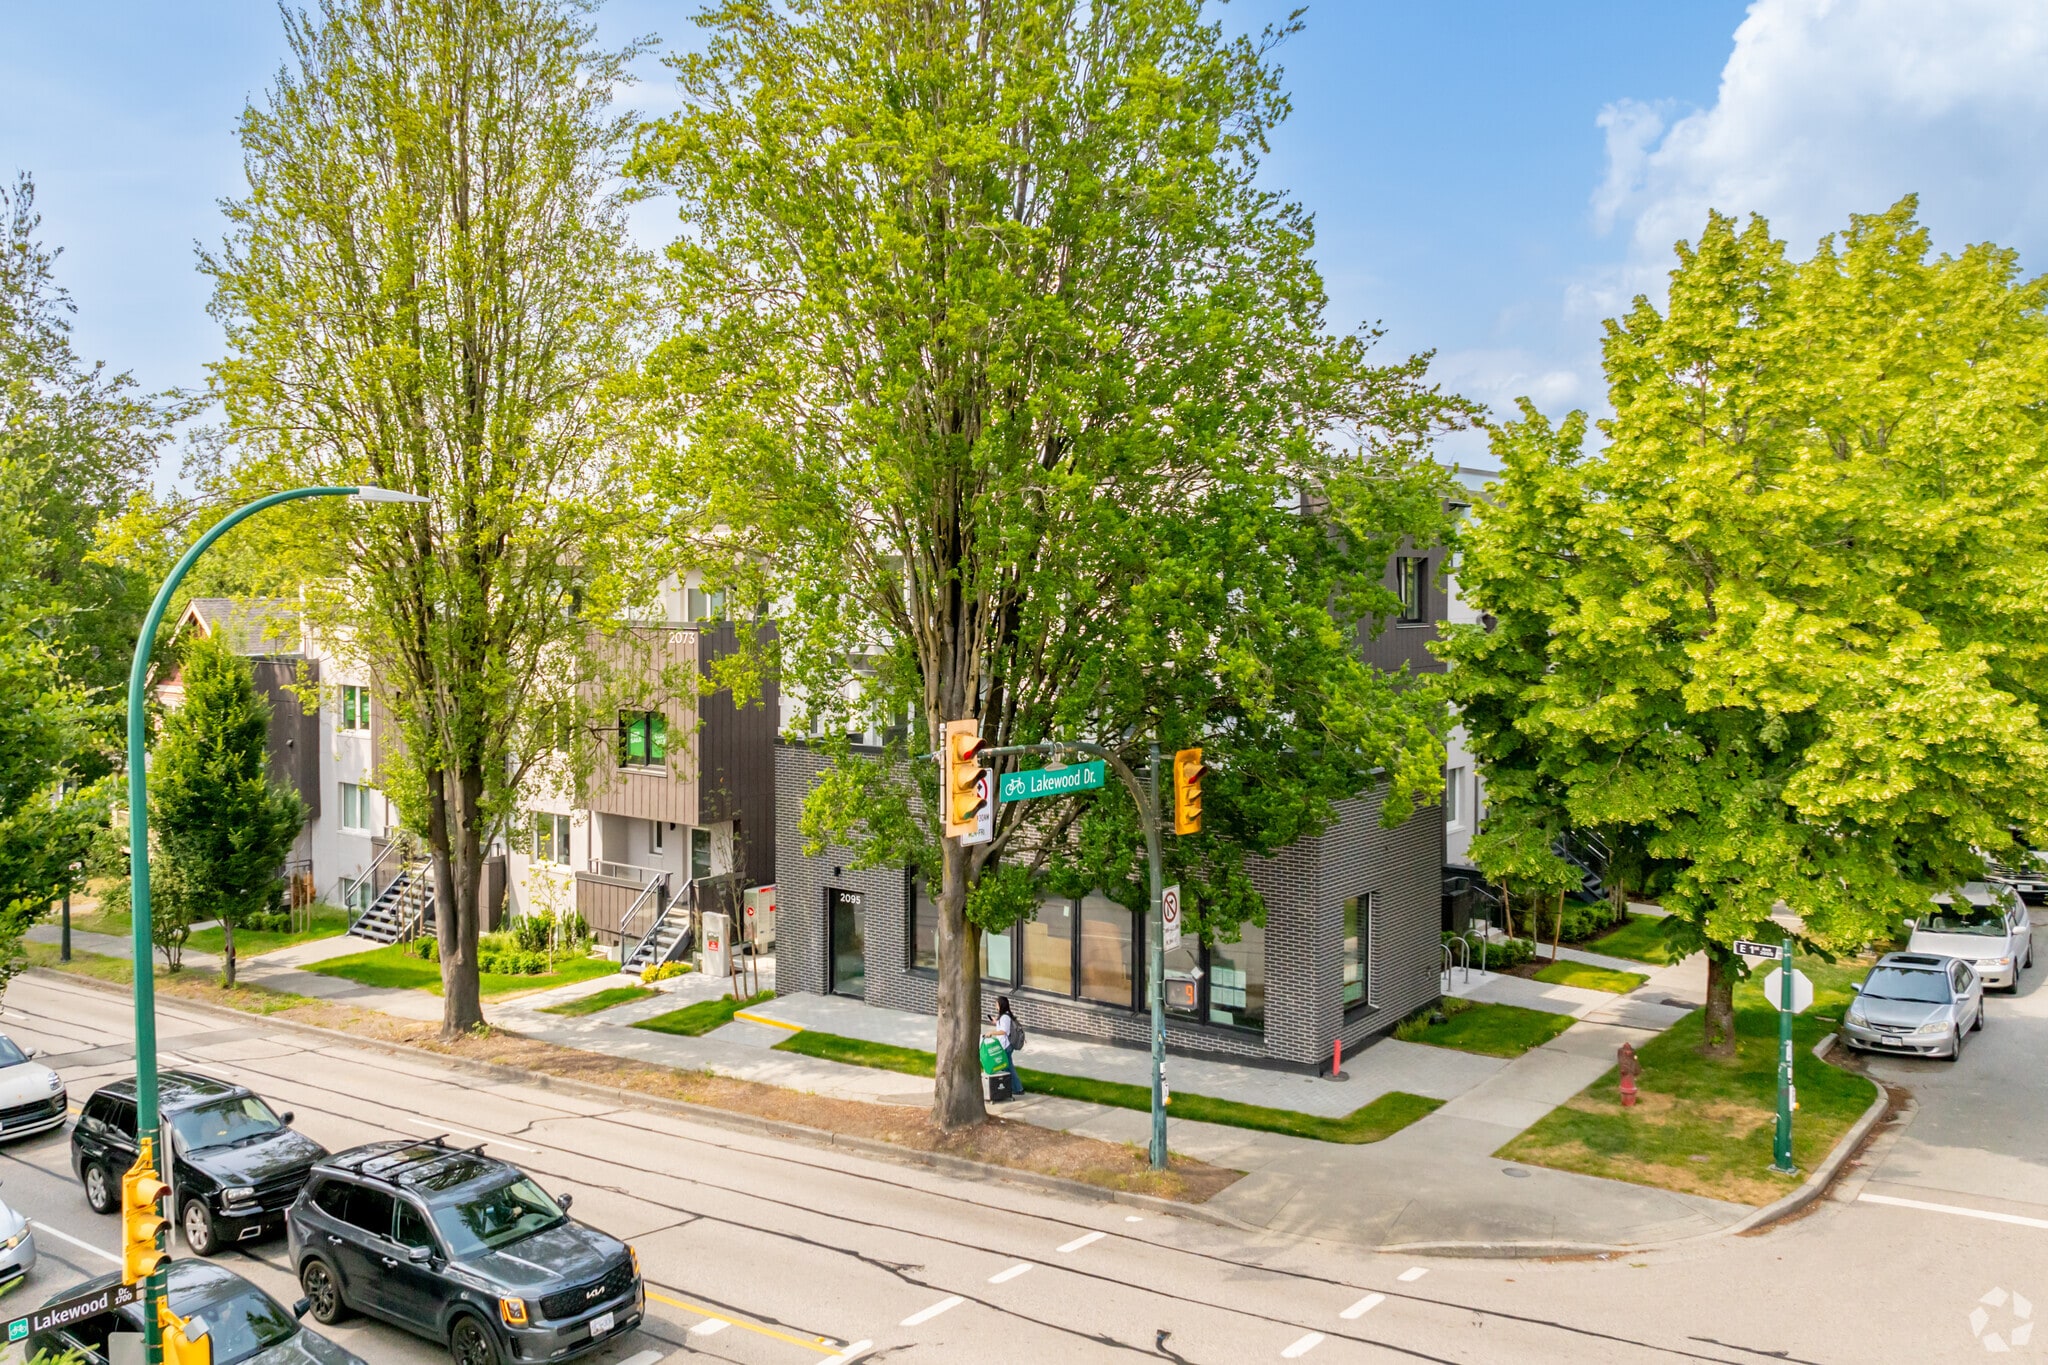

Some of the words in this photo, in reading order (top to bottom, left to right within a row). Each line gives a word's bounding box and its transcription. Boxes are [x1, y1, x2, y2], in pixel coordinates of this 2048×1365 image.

[669, 631, 695, 645] 2073
[1031, 769, 1080, 793] Lakewood
[1083, 768, 1096, 784] Dr.
[840, 893, 861, 904] 2095
[1740, 944, 1746, 953] E
[1185, 984, 1194, 1005] 9
[118, 1287, 129, 1296] Dr.
[114, 1292, 133, 1305] 1700
[33, 1292, 108, 1332] Lakewood
